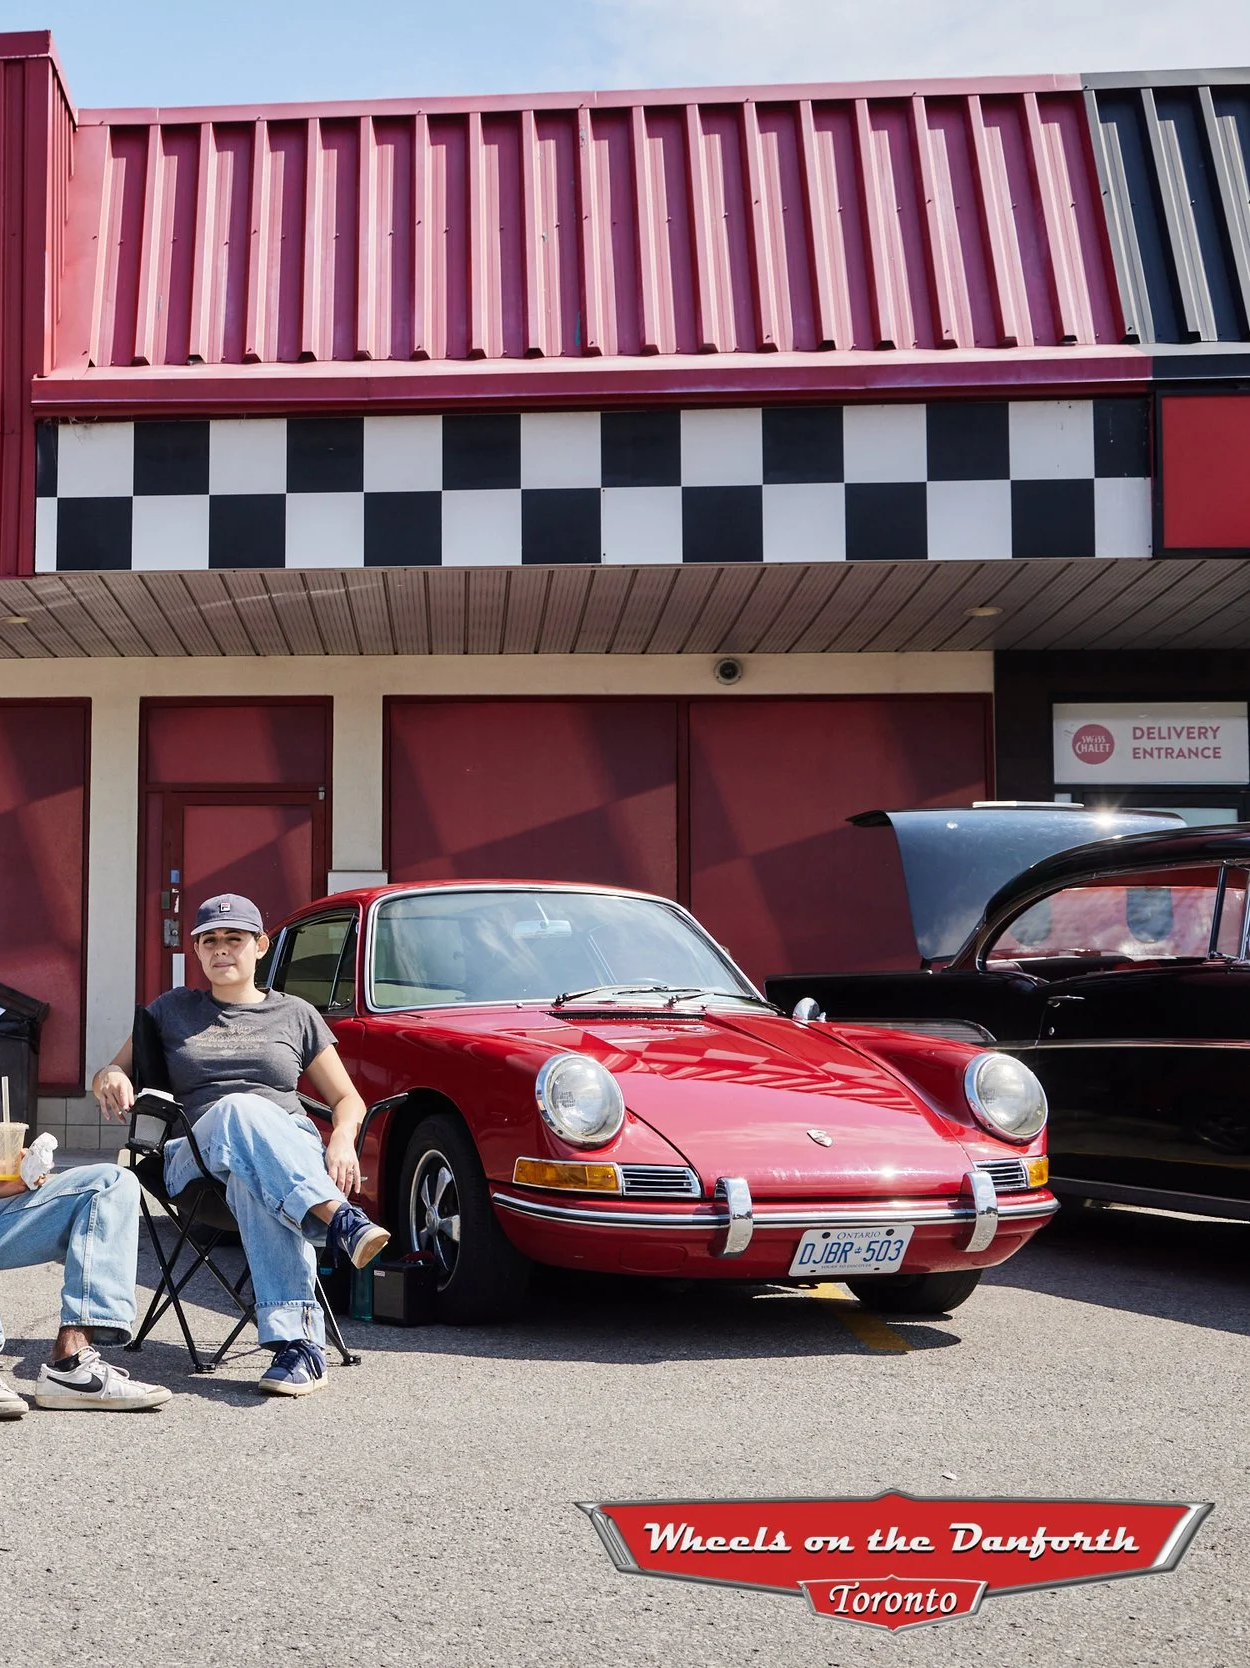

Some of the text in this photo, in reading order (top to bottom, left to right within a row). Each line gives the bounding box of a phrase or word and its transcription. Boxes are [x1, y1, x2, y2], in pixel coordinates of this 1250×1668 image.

[1132, 726, 1221, 740] DELIVERY
[1075, 742, 1110, 754] CHALET
[1132, 747, 1222, 759] ENTRANCE
[837, 1231, 881, 1239] ONTARIO
[798, 1240, 904, 1265] DJBR 503
